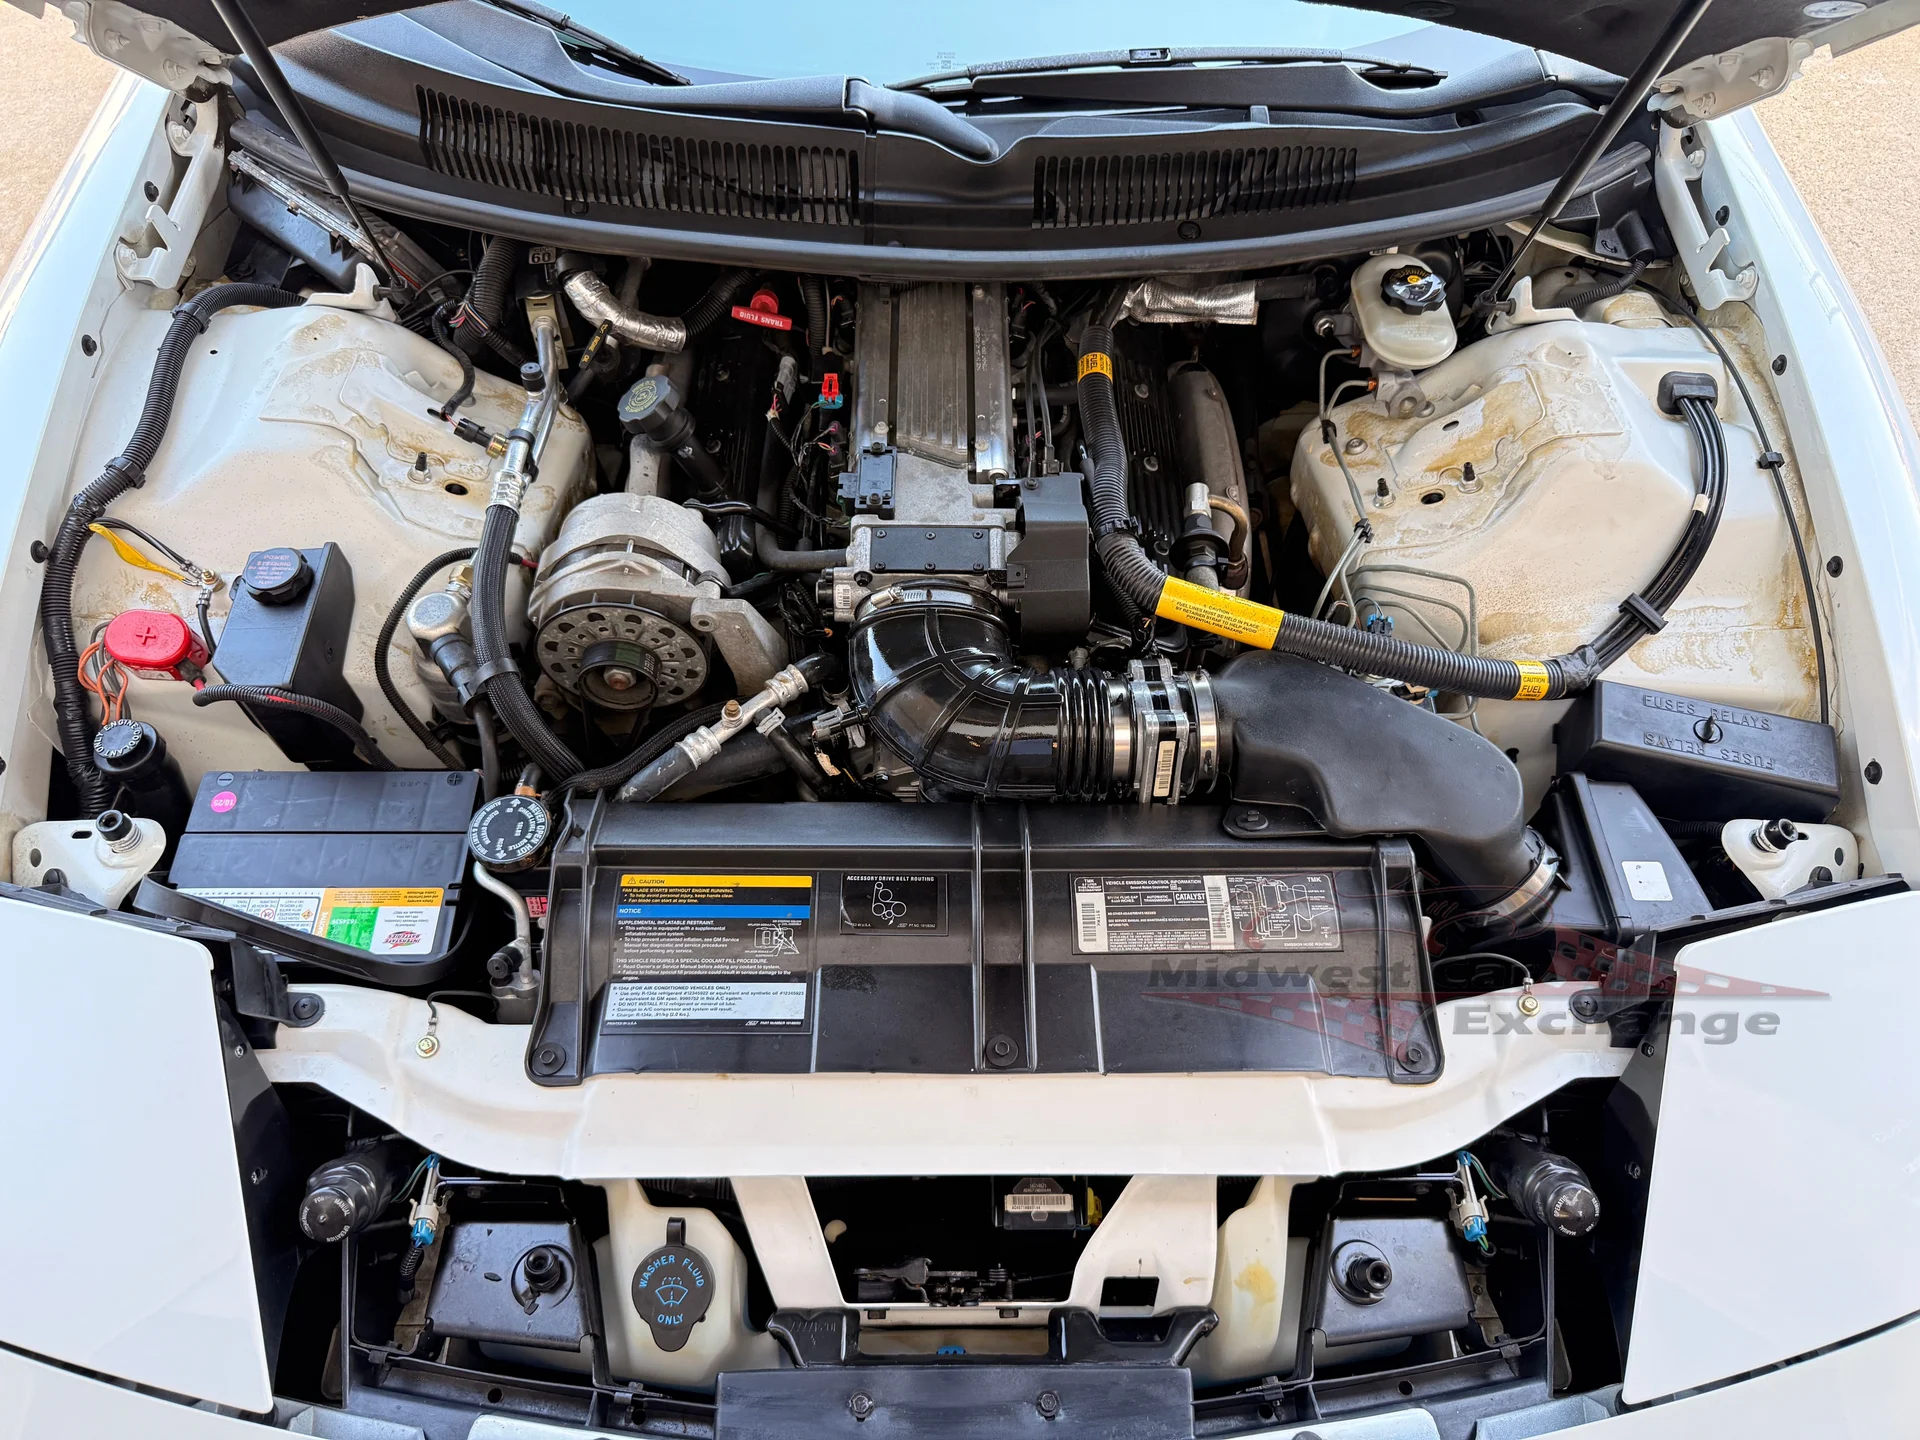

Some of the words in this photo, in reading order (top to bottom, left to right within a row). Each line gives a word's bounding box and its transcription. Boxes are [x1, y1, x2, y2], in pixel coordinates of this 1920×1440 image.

[531, 252, 550, 263] 60
[740, 312, 758, 322] FLUID
[760, 317, 784, 328] TRANS
[582, 354, 590, 362] OIL
[1203, 608, 1216, 617] MUST
[1224, 614, 1237, 622] HELD
[1243, 620, 1259, 629] PLACE
[1208, 605, 1230, 616] CAUTION
[1182, 608, 1206, 619] RETAINER
[1206, 614, 1222, 623] STRAP
[1229, 621, 1242, 630] HELP
[1242, 625, 1257, 634] AVOID
[1186, 614, 1212, 625] POTENTIAL
[1224, 625, 1243, 634] HAZARD
[1521, 685, 1542, 694] FUEL
[1643, 694, 1696, 715] FUSES
[1710, 708, 1772, 731] RELAYS
[104, 719, 140, 731] ENGINE
[94, 732, 104, 753] ONLY
[105, 730, 141, 757] COOLANT
[1644, 732, 1705, 755] RELAYS
[1720, 749, 1775, 770] FUSES
[213, 799, 235, 807] 10/25
[518, 806, 534, 819] CHECK
[527, 803, 546, 824] NEVER
[530, 825, 546, 844] OPEN
[507, 838, 528, 852] BOTTLE
[516, 844, 533, 857] HOT
[334, 1198, 350, 1217] MANUAL
[1591, 1198, 1600, 1217] REMOVE
[326, 1225, 350, 1242] OPERATION
[1558, 1224, 1576, 1236] MANUAL
[639, 1254, 675, 1288] WASHER
[682, 1258, 705, 1287] FLUID
[657, 1314, 684, 1325] ONLY
